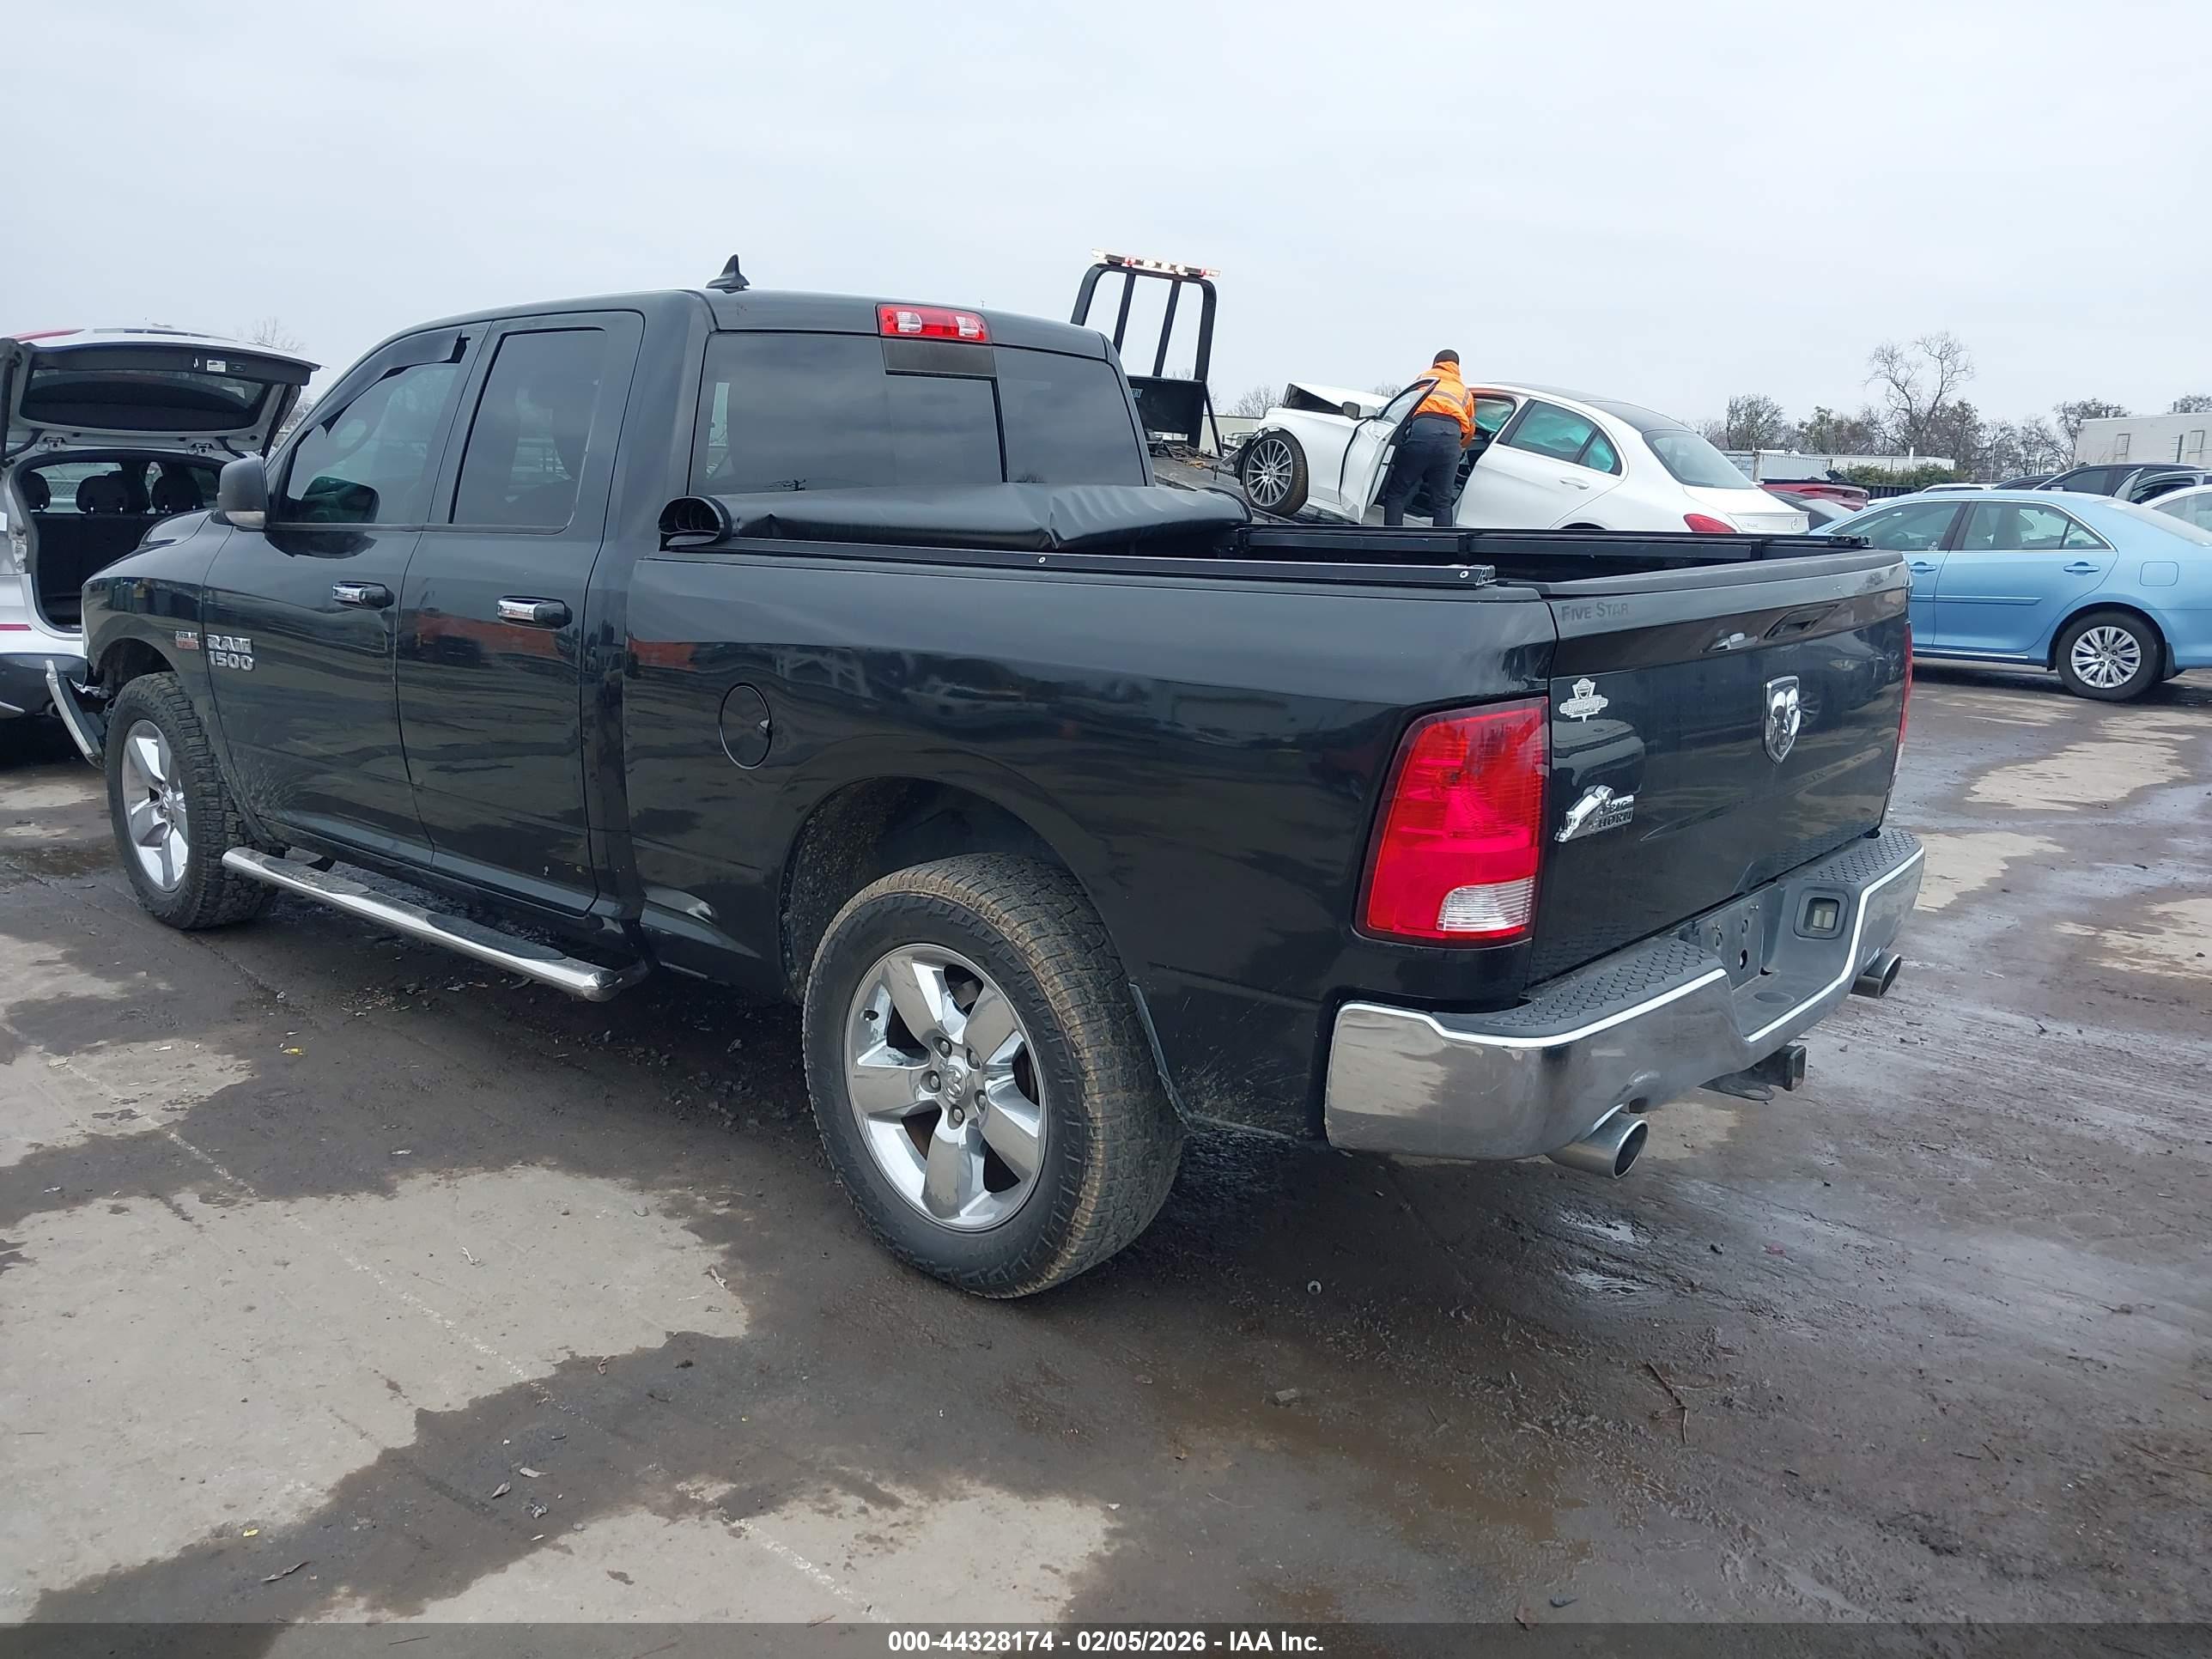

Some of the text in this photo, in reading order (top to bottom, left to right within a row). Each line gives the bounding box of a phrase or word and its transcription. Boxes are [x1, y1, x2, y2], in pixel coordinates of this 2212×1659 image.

[207, 634, 252, 653] RAM
[209, 651, 254, 672] 1500
[1598, 810, 1632, 827] HORN
